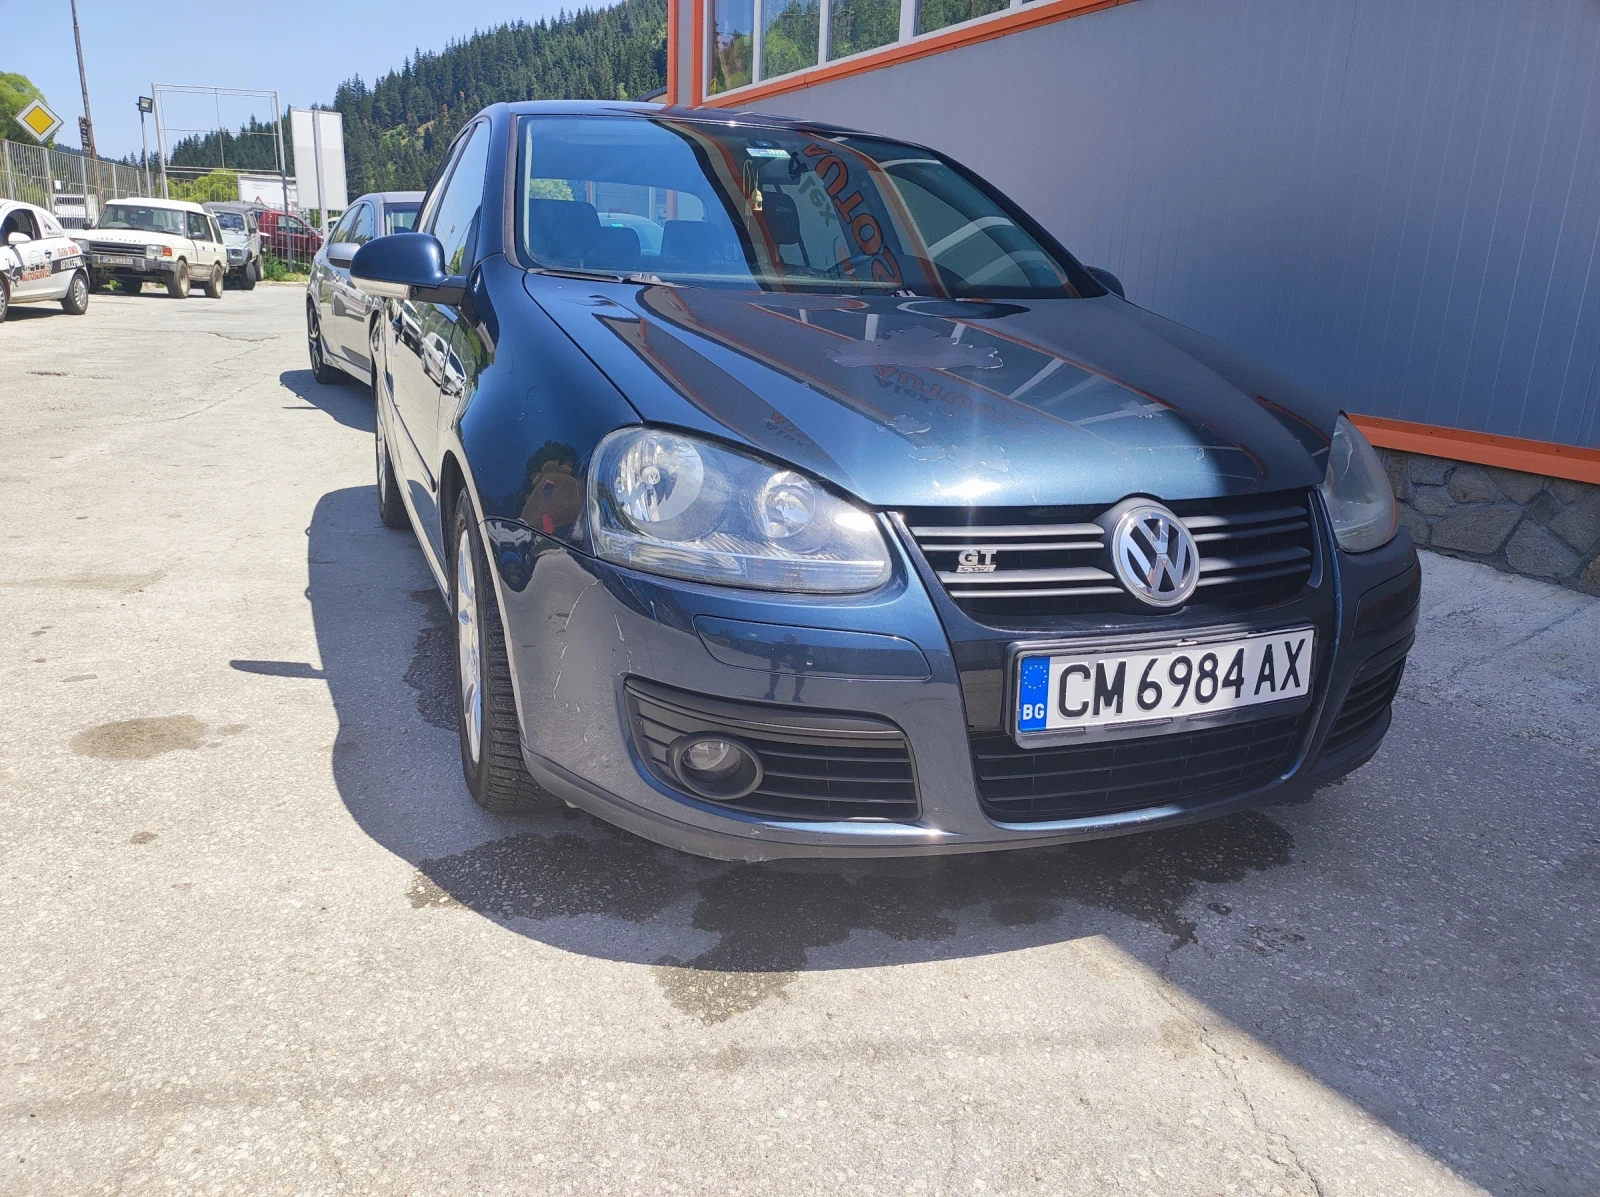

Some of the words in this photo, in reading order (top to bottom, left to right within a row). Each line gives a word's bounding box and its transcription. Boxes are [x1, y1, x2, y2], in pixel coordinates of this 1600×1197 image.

[958, 549, 998, 566] GT
[1058, 660, 1127, 718] CM
[1136, 647, 1246, 711] 6984
[1253, 638, 1306, 696] AX
[1022, 703, 1045, 721] BG
